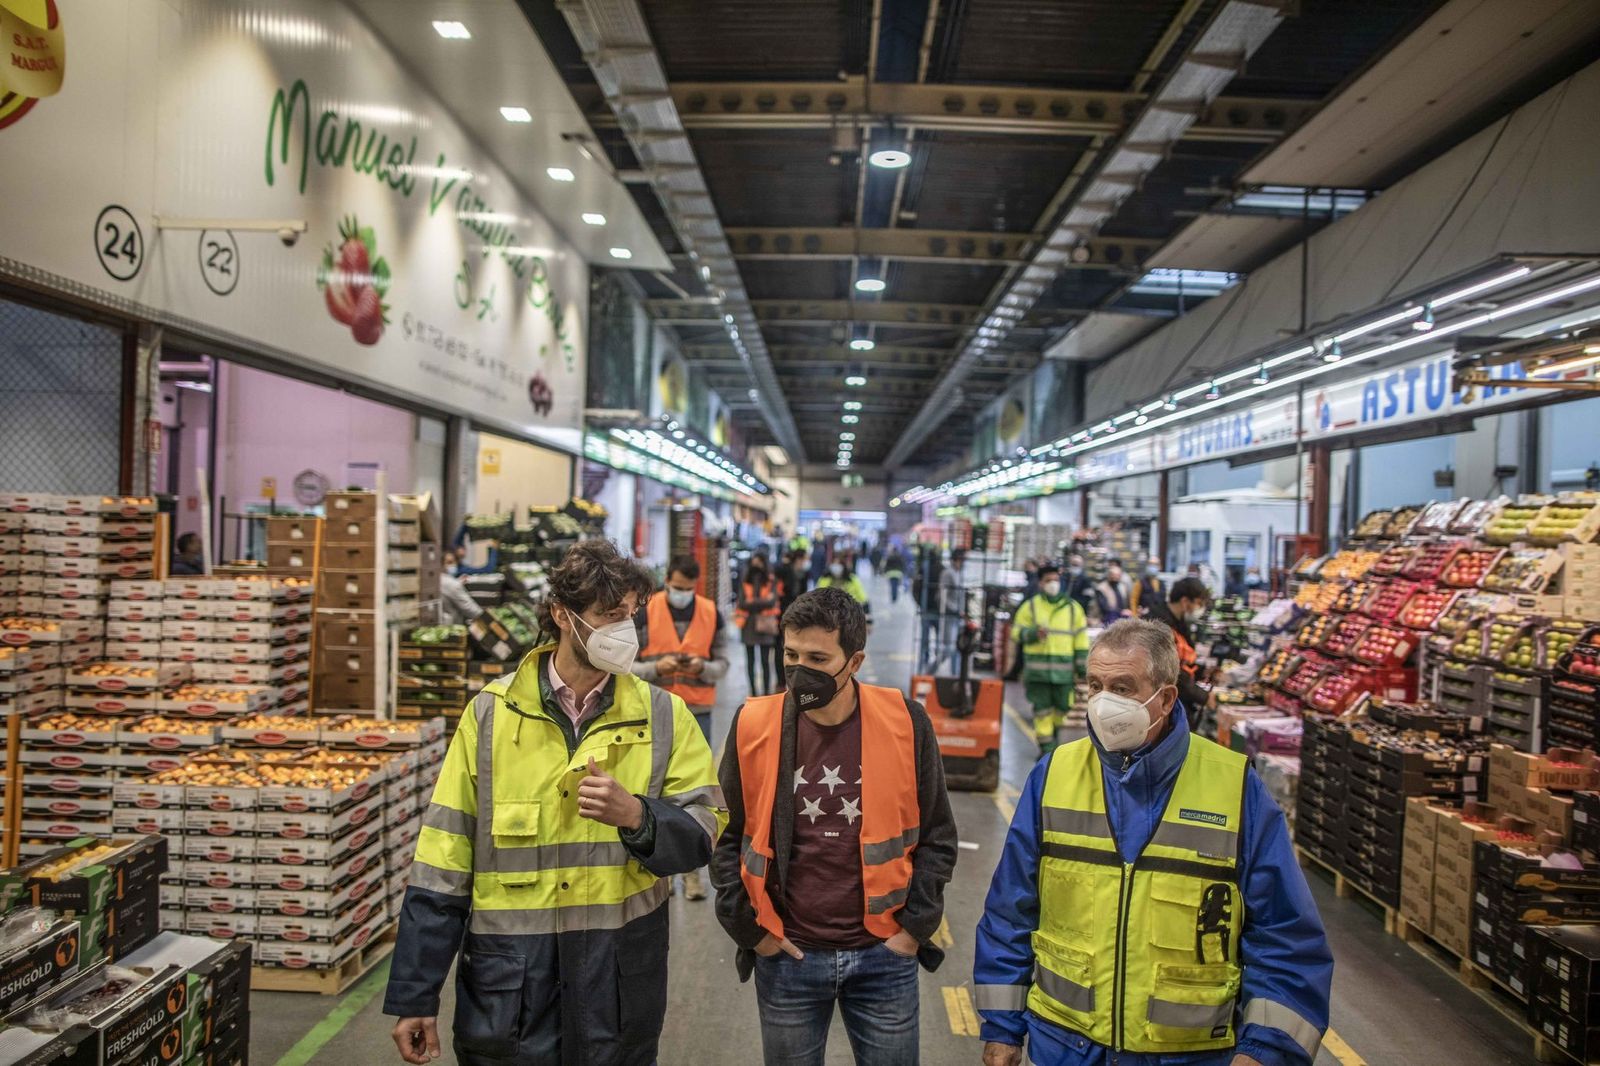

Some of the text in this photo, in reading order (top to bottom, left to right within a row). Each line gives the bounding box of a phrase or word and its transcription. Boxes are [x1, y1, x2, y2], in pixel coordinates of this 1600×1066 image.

[265, 79, 417, 196] Manuel
[103, 221, 137, 265] 24
[206, 241, 233, 276] 22
[1180, 811, 1226, 825] mercamadrid
[106, 1009, 165, 1059] FRESHGOLD
